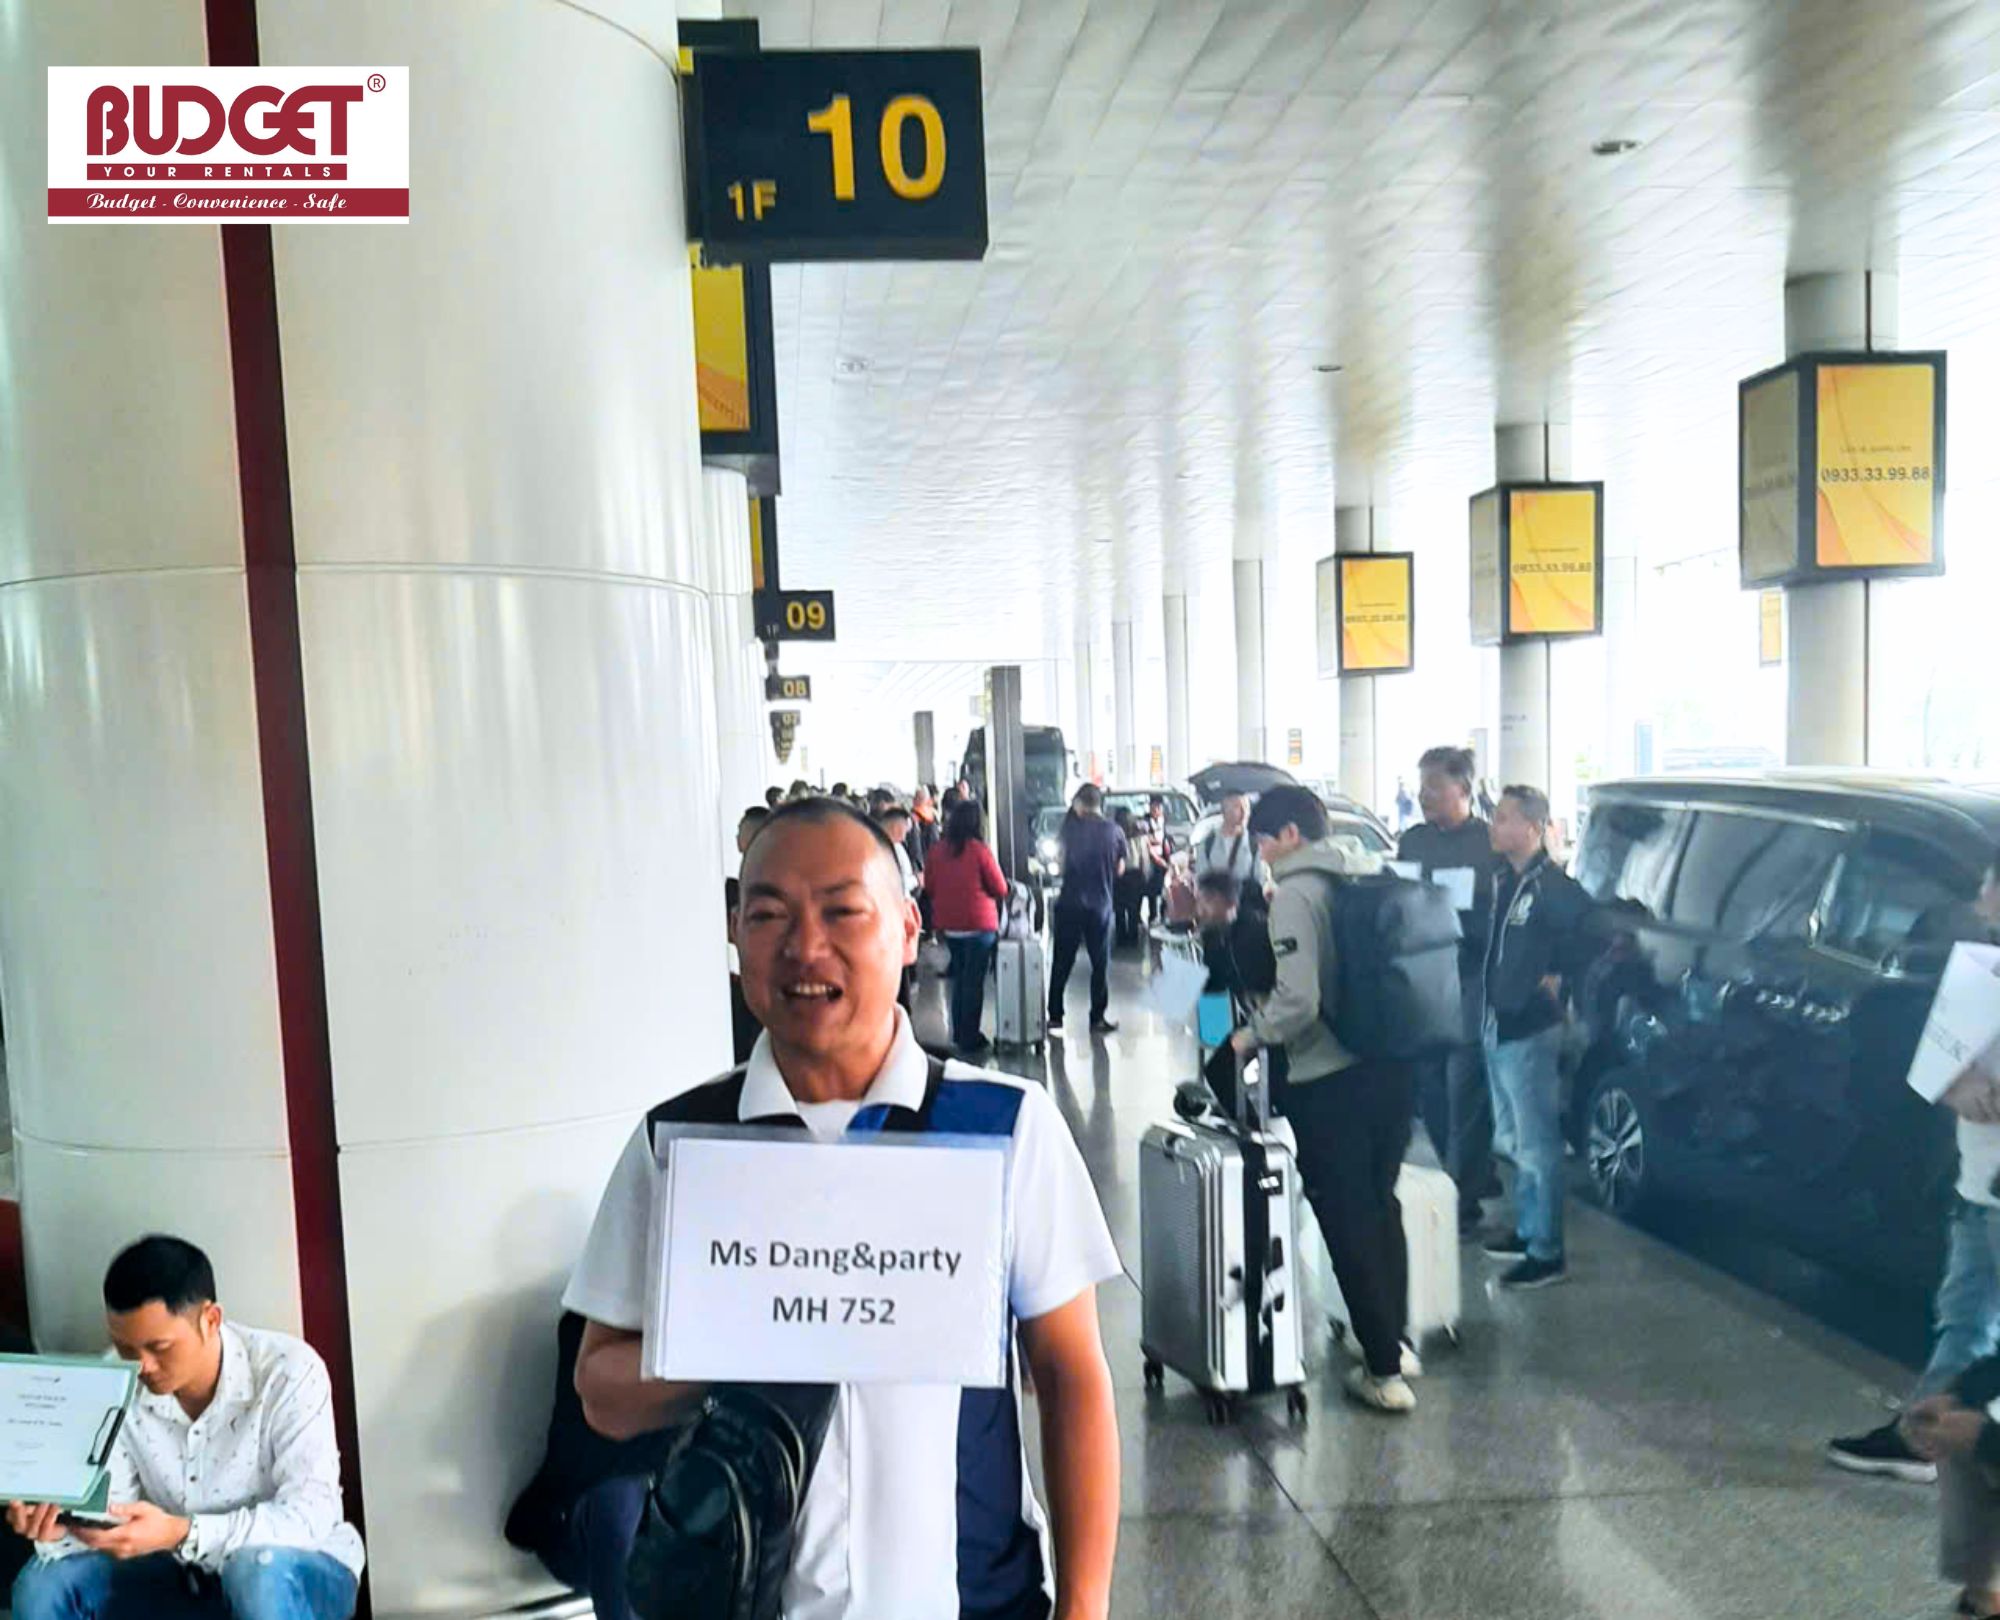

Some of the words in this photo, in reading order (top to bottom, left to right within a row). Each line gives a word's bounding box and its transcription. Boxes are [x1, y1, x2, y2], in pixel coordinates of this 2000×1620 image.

[807, 94, 946, 200] 10
[728, 180, 776, 220] 1F
[787, 600, 826, 629] 09
[710, 1240, 757, 1267] Ms
[769, 1241, 961, 1277] Dang&party
[773, 1296, 828, 1323] MH
[840, 1297, 896, 1325] 752
